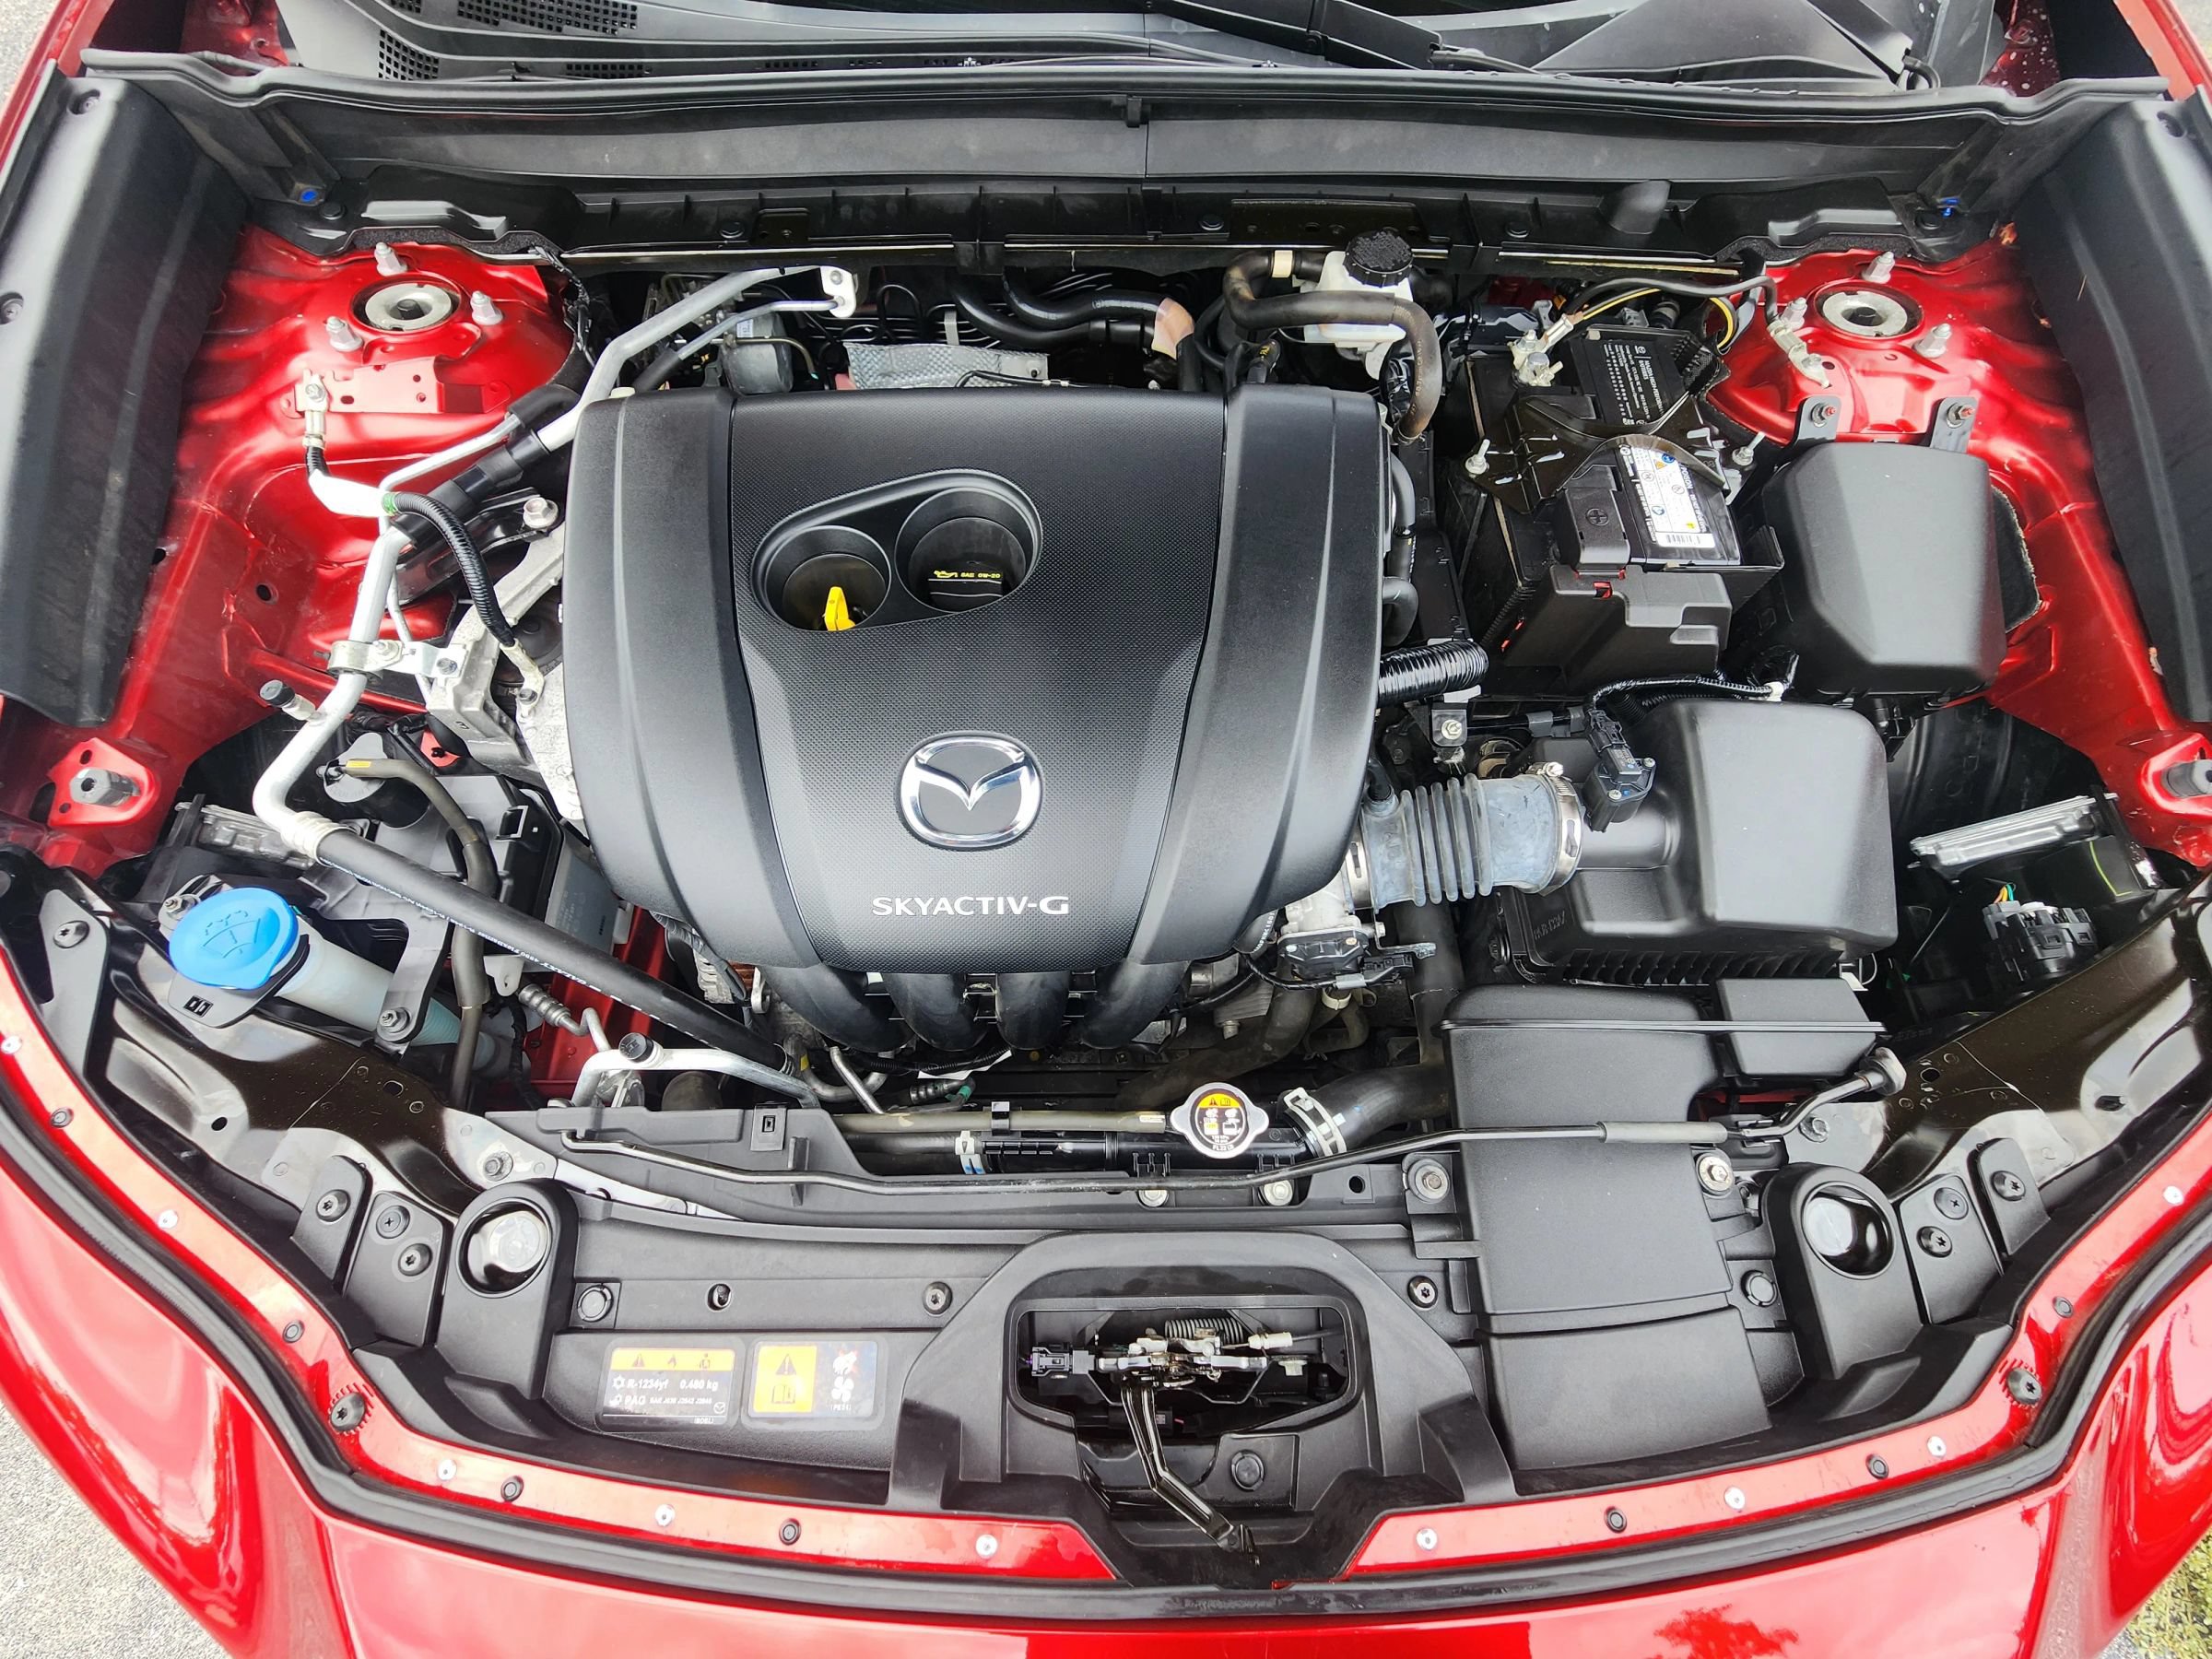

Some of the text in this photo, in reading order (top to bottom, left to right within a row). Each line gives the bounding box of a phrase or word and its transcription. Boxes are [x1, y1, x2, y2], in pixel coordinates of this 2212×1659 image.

[1679, 465, 1694, 488] POISON
[872, 895, 1069, 916] SKYACTIV-G
[539, 959, 587, 986] GALAXY
[627, 1379, 669, 1391] R-1234yf
[706, 1379, 719, 1392] kg
[625, 1394, 646, 1406] PAG
